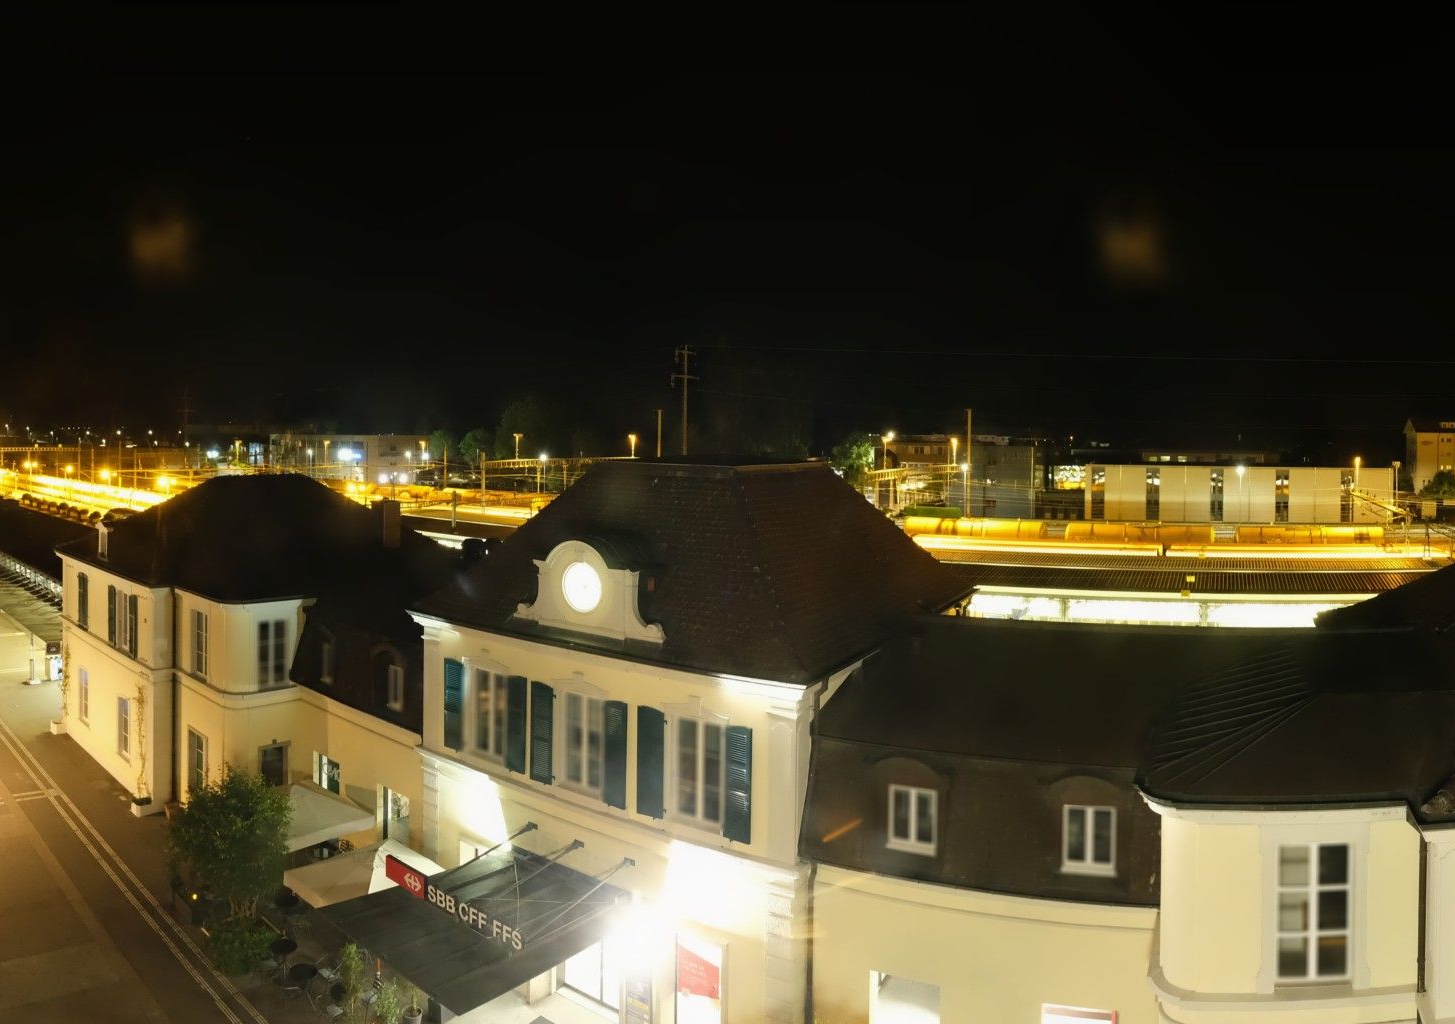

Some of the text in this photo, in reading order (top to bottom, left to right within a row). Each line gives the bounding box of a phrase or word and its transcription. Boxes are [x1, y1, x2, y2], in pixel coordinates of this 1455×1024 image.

[427, 885, 523, 950] SBB CFF FFS
